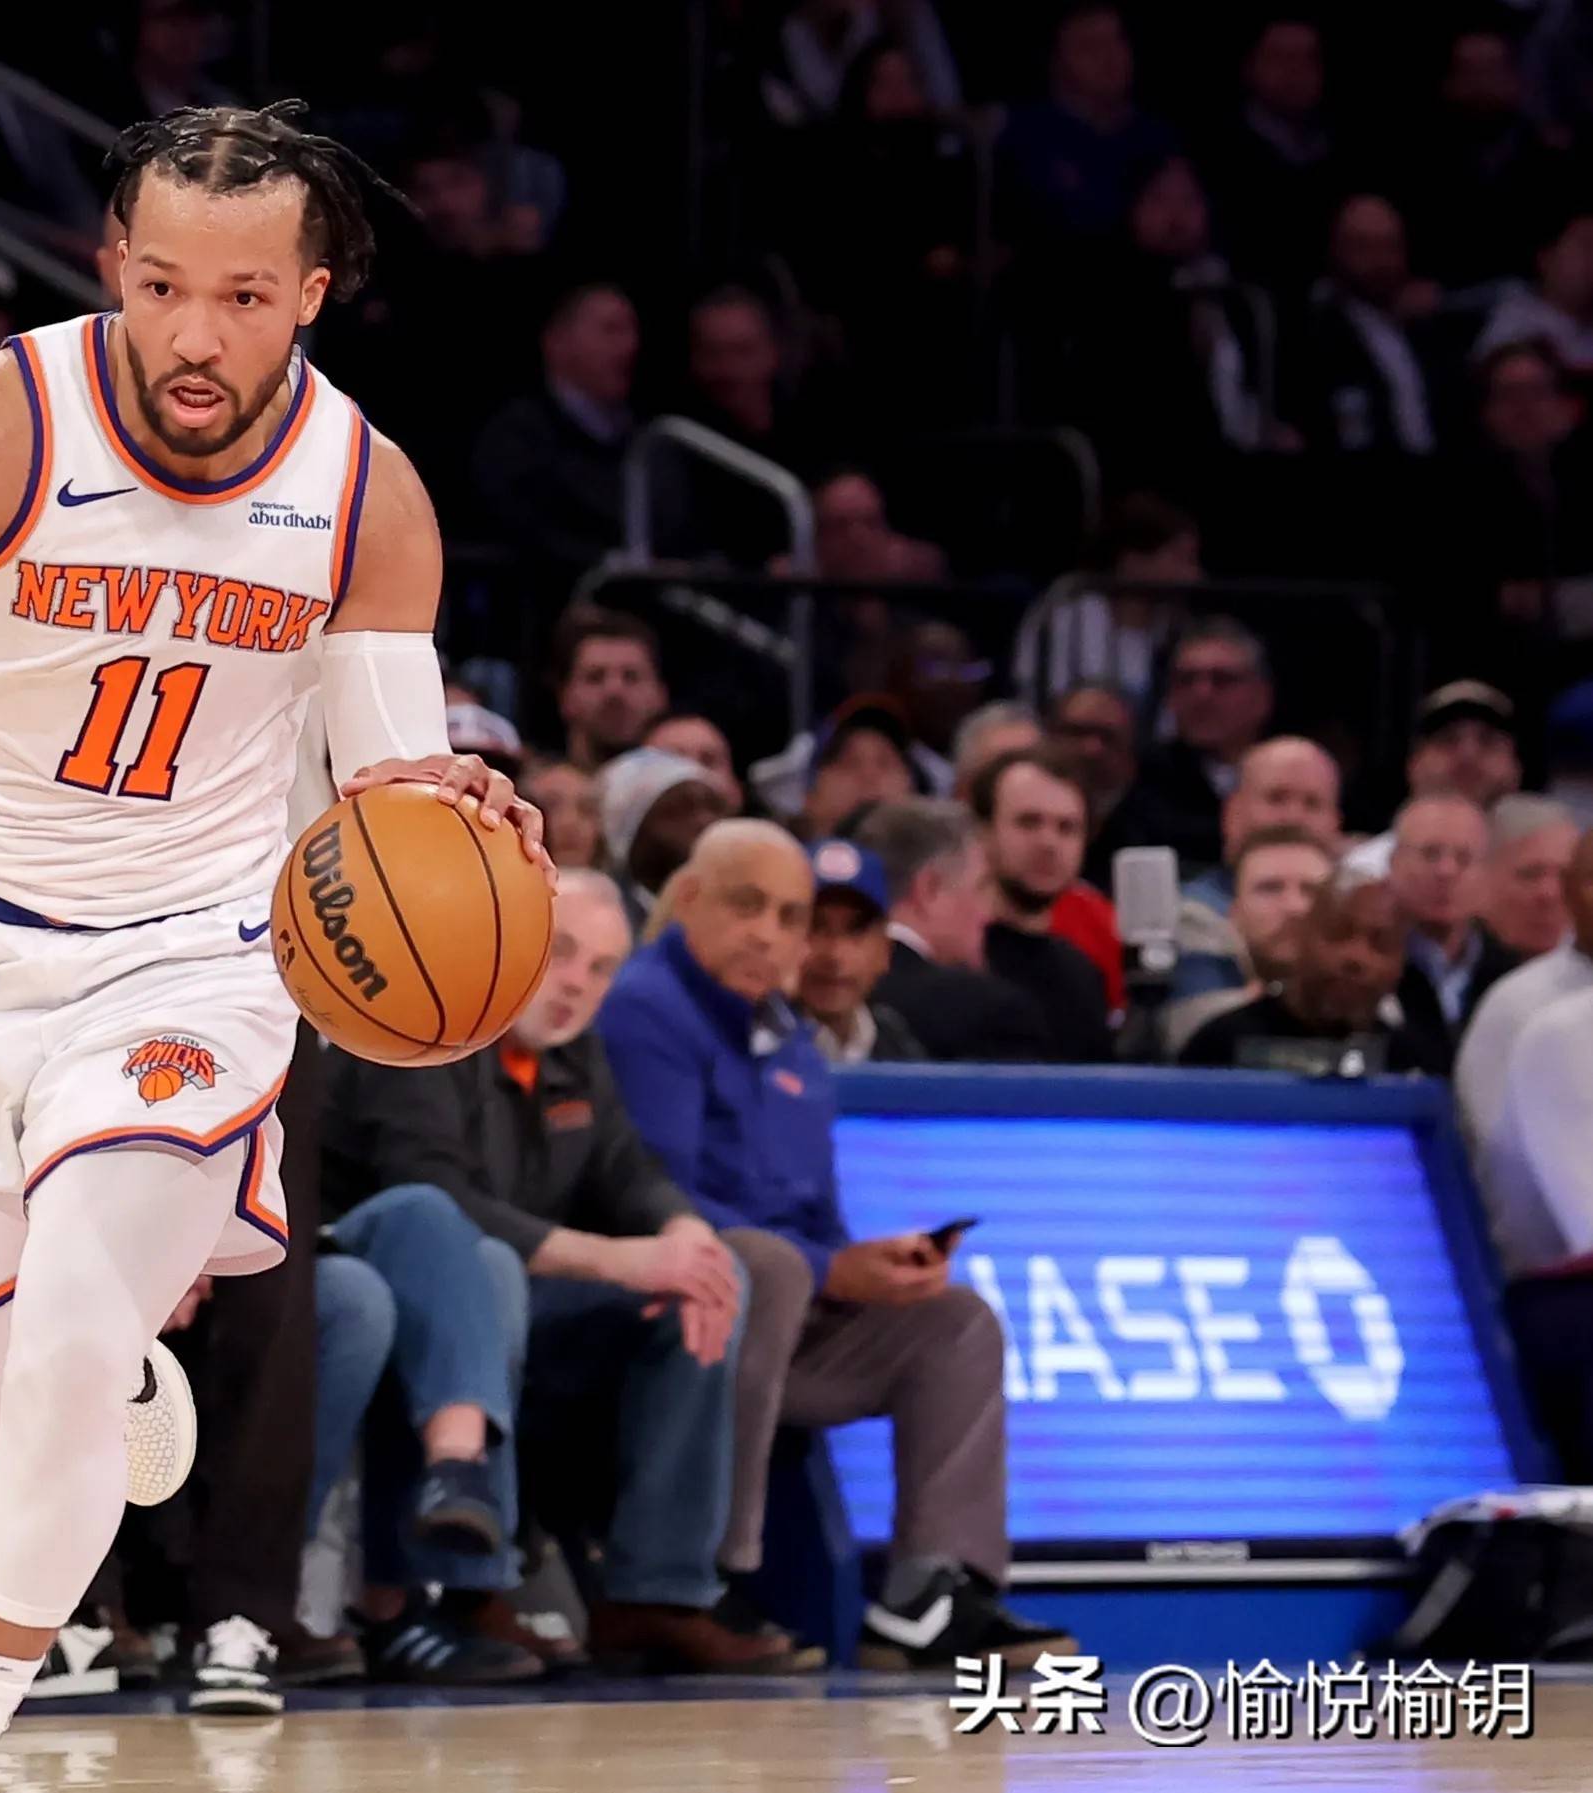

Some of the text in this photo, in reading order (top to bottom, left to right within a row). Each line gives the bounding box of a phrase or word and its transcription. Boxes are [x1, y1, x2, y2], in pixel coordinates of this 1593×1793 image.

[248, 511, 332, 530] abu dhabi
[11, 560, 329, 653] NEW YORK
[54, 655, 211, 801] 11
[302, 820, 389, 1002] Wilson
[122, 1039, 215, 1088] KNICKS
[967, 1255, 1287, 1401] ASE
